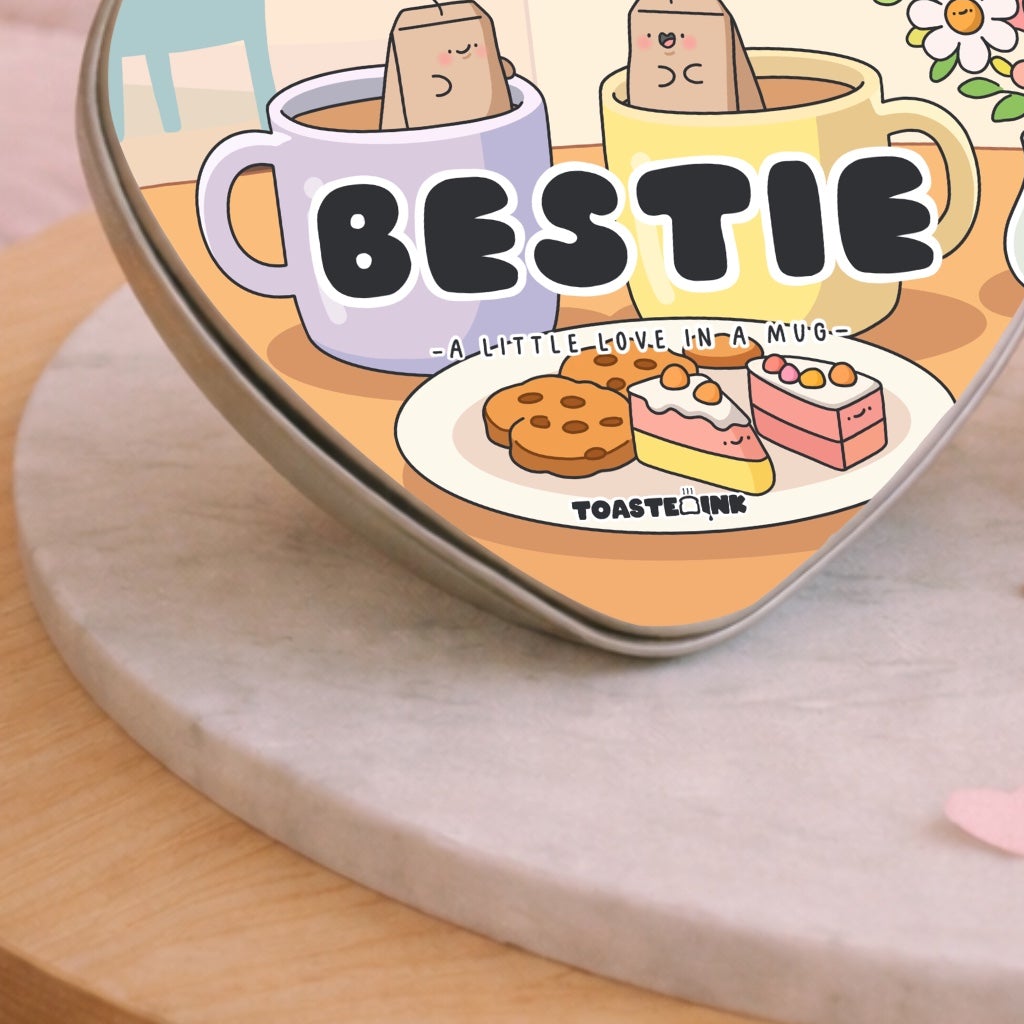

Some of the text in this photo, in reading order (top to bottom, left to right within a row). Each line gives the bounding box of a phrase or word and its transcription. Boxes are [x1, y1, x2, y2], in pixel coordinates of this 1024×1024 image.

[315, 154, 935, 299] BESTIE
[482, 333, 579, 357] LITTLE
[598, 329, 666, 353] LOVE
[684, 327, 712, 347] IN
[732, 325, 747, 346] A
